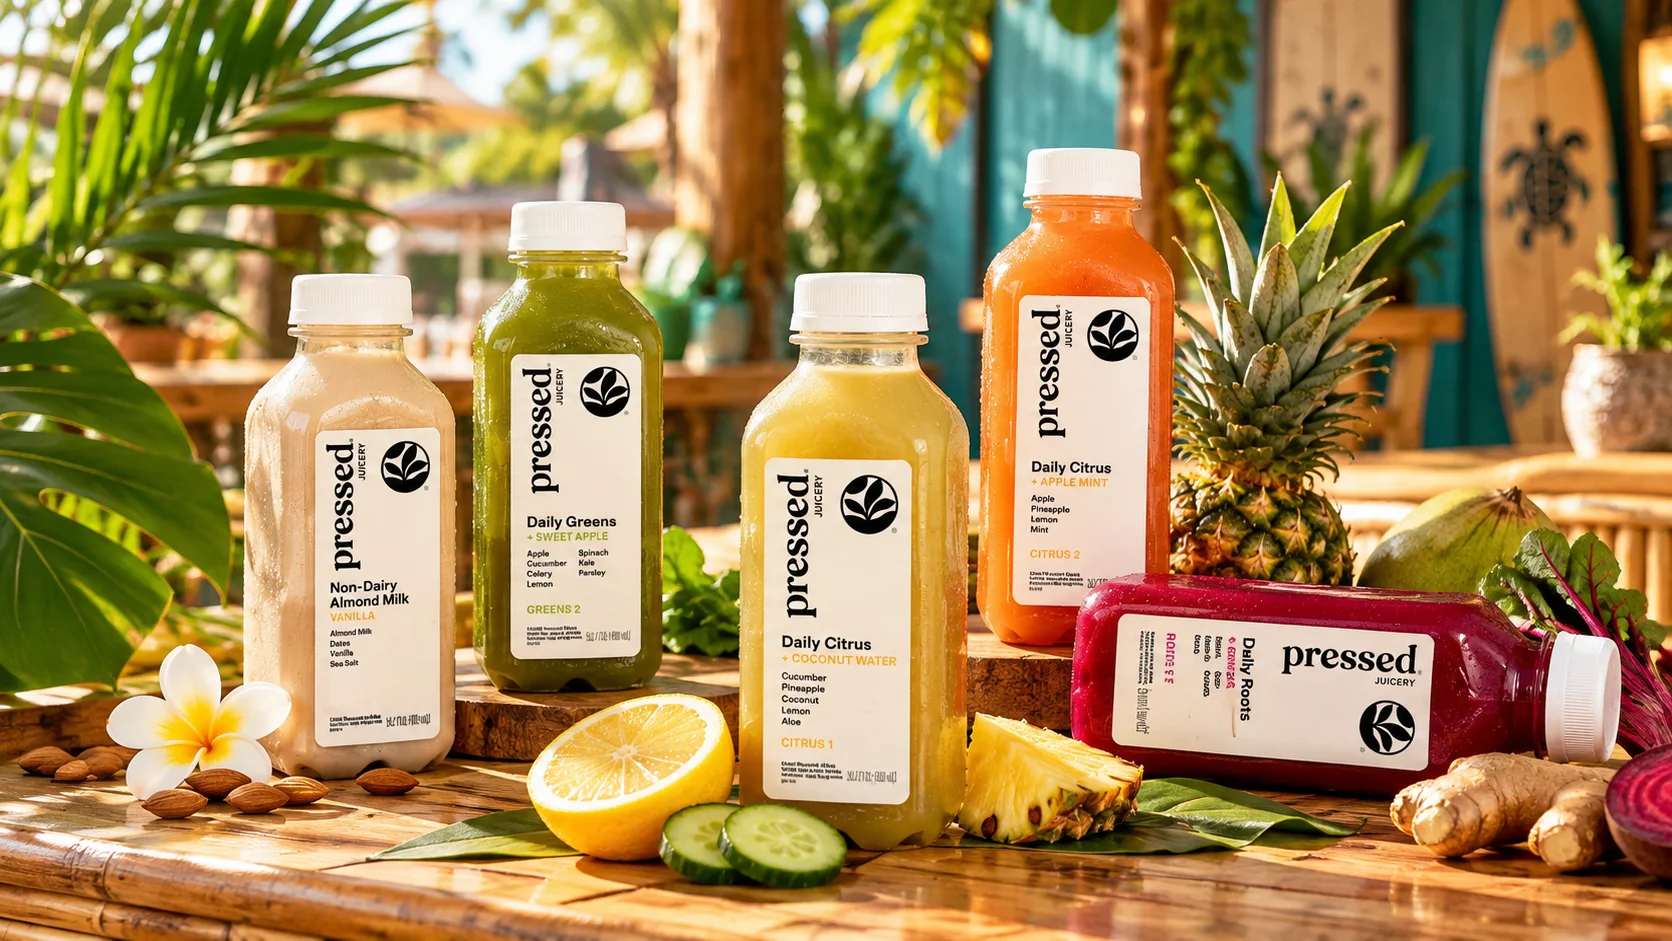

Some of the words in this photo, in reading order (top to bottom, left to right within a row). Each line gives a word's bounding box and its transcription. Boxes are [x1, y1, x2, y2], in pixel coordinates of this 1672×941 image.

[1065, 309, 1073, 348] JUICERY
[1031, 309, 1066, 438] pressed
[556, 368, 564, 405] JUICERY
[522, 367, 560, 494] pressed
[358, 443, 366, 480] JUICERY
[1031, 461, 1066, 476] Daily
[1069, 461, 1112, 474] Citrus
[1040, 477, 1077, 487] APPLE
[1078, 478, 1109, 488] MINT
[814, 475, 823, 517] JUICERY
[1031, 494, 1055, 503] Apple
[326, 443, 361, 571] pressed
[1031, 505, 1070, 514] Pineapple
[527, 516, 563, 530] Daily
[566, 516, 617, 528] Greens
[1030, 525, 1049, 533] Mint
[536, 532, 573, 542] SWEET
[575, 532, 609, 541] APPLE
[777, 474, 817, 618] pressed
[527, 550, 550, 559] Apple
[578, 549, 609, 558] Spinach
[1029, 549, 1071, 559] CITRUS
[1073, 550, 1081, 559] 2
[527, 560, 567, 568] Cucumber
[330, 580, 398, 594] Non-Dairy
[527, 580, 554, 588] Lemon
[330, 595, 380, 609] Almond
[382, 593, 410, 606] Milk
[527, 604, 572, 615] GREENS
[574, 604, 582, 614] 2
[330, 611, 376, 622] VANILLA
[330, 629, 357, 638] Almond
[781, 635, 821, 652] Daily
[824, 636, 872, 651] Citrus
[792, 653, 853, 665] COCONUT
[855, 655, 897, 666] WATER
[1281, 644, 1418, 675] pressed
[781, 672, 827, 682] Cucumber
[1374, 676, 1416, 687] JUICERY
[781, 683, 826, 694] Pineapple
[781, 695, 819, 704] Coconut
[1239, 678, 1254, 722] Roots
[781, 706, 811, 715] Lemon
[781, 717, 801, 726] Aloe
[781, 737, 825, 749] CITRUS
[828, 739, 834, 749] 1
